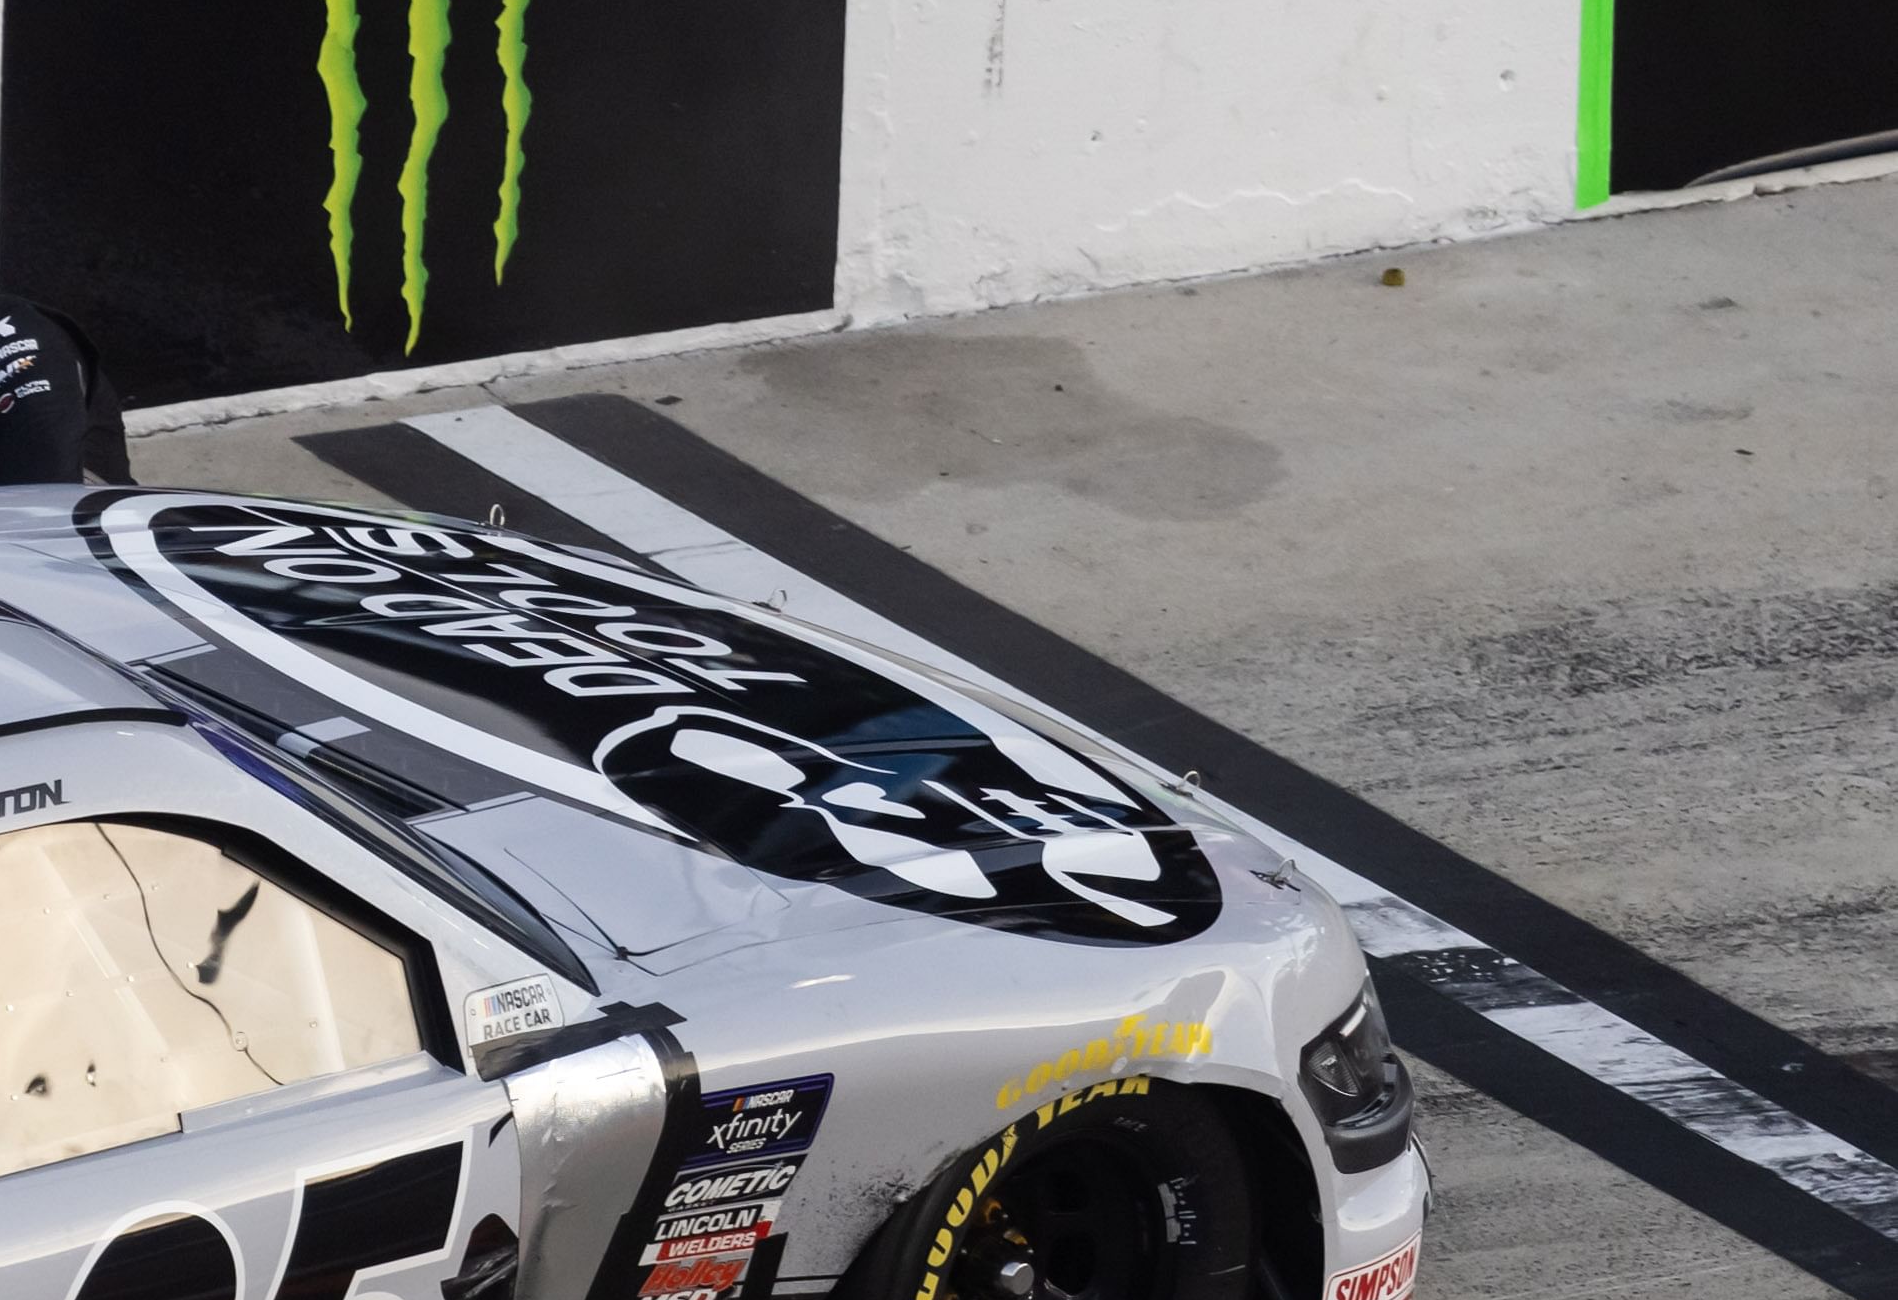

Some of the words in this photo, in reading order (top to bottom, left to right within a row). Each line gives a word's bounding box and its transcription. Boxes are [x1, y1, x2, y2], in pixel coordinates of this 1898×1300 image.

[191, 526, 401, 586] ON
[340, 526, 808, 688] TOOLS
[360, 589, 670, 699] DEAD
[496, 983, 547, 1014] NASCAR
[483, 1016, 521, 1040] RACE
[524, 1008, 552, 1028] CAR
[995, 1013, 1213, 1110] GOODYEAR
[747, 1089, 794, 1109] NASCAR
[706, 1108, 803, 1150] xfinity
[726, 1137, 766, 1153] SERIES
[663, 1165, 796, 1207] COMETIC
[655, 1208, 757, 1241] LINCOLN
[668, 1231, 757, 1258] WELDERS
[637, 1257, 749, 1296] Holley
